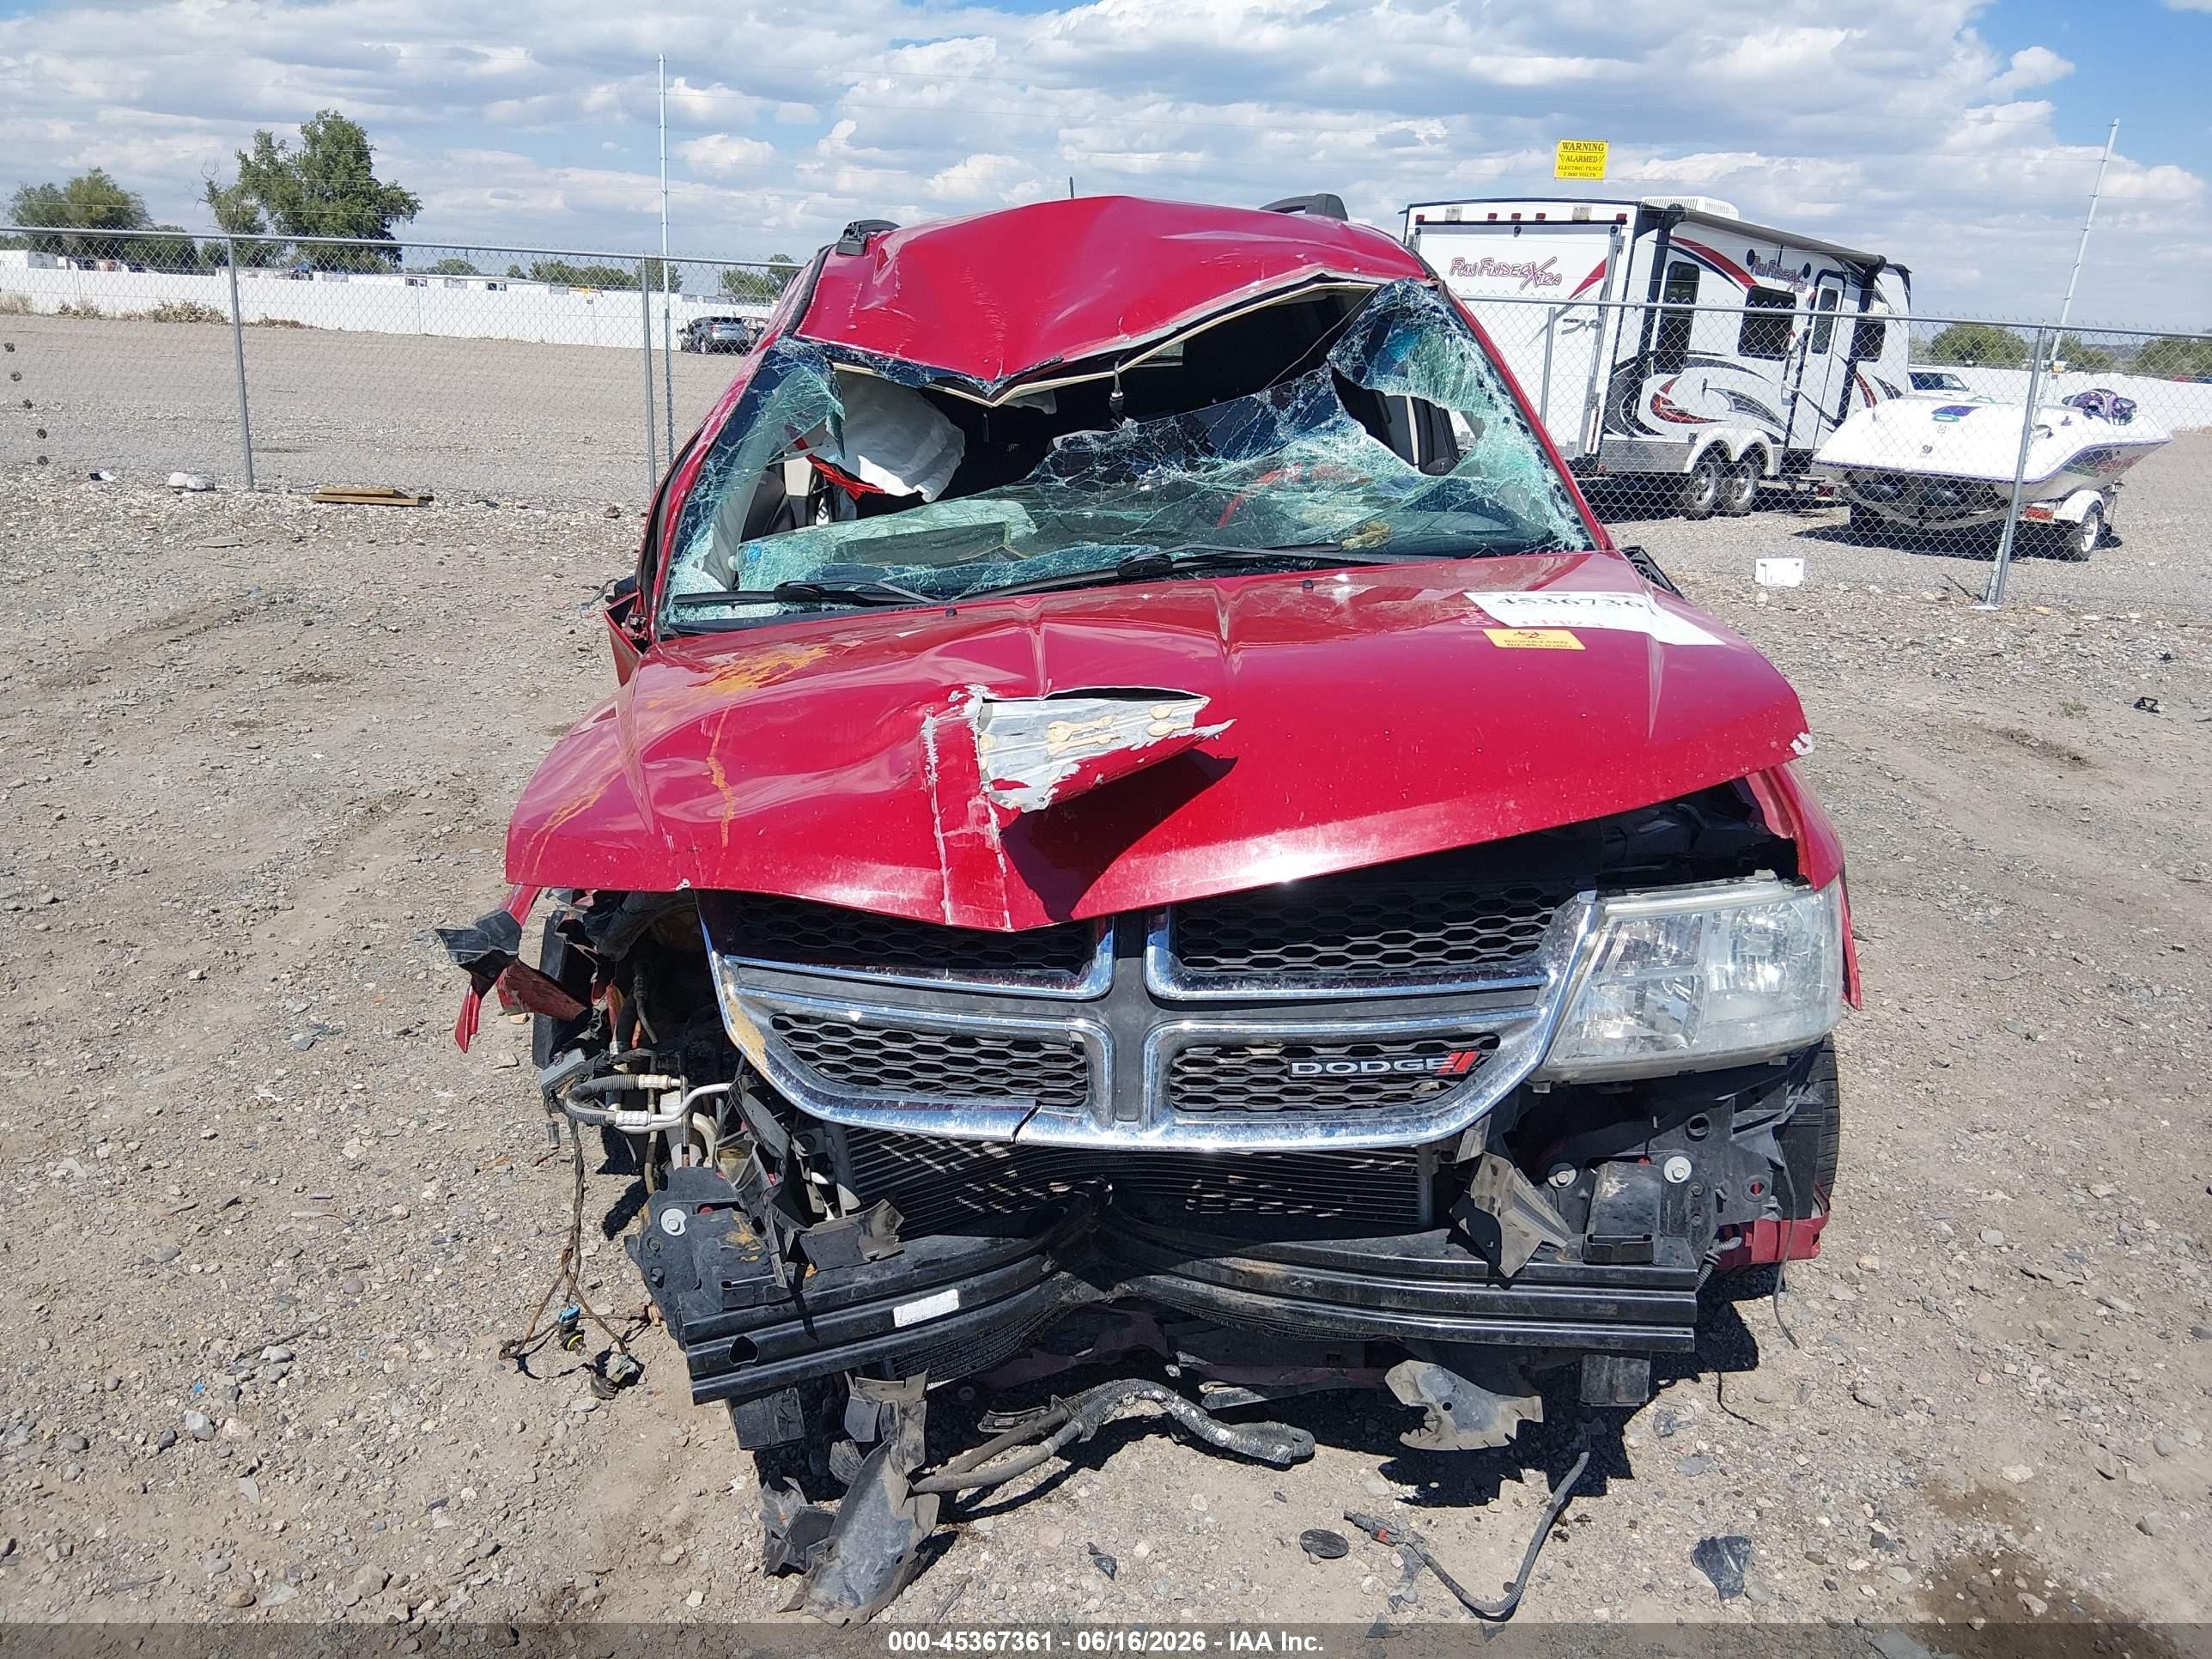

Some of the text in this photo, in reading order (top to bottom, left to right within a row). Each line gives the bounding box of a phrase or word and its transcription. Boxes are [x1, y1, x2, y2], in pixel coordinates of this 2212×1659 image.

[1562, 142, 1604, 151] WARNING
[1565, 155, 1598, 163] ALARMED
[1449, 258, 1479, 276] FUN
[1291, 1057, 1454, 1074] DODGE
